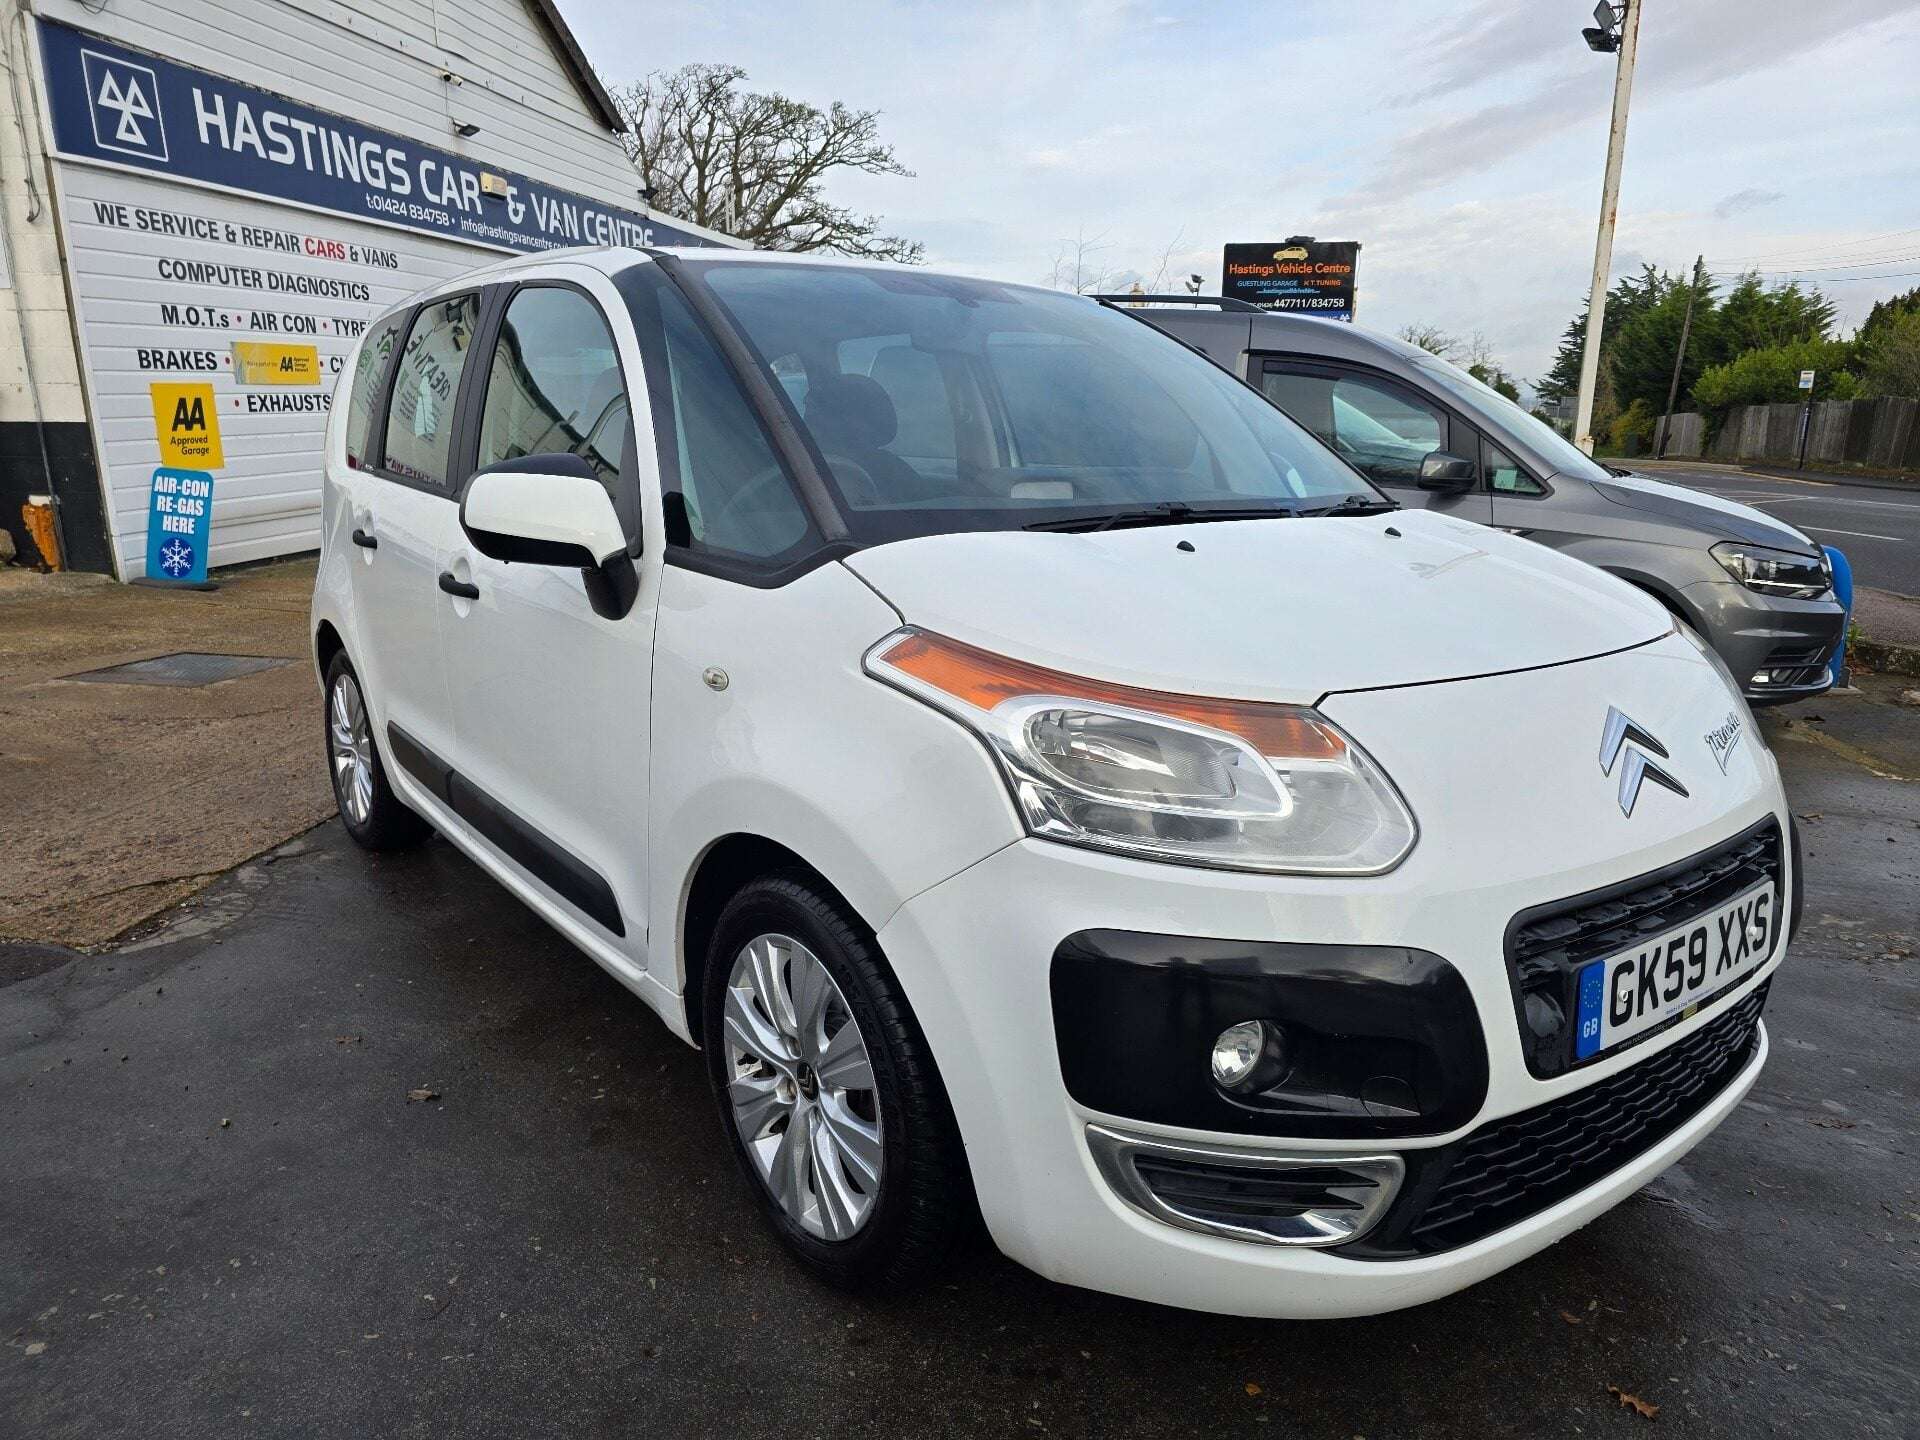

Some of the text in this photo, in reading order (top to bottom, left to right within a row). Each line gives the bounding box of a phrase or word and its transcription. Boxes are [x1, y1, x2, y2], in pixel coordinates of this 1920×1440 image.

[193, 88, 411, 196] HASTINGS
[419, 160, 483, 214] CAR
[505, 186, 526, 224] &
[530, 193, 580, 240] VAN
[409, 203, 450, 226] 834758
[94, 202, 398, 269] WE SERVICE & REPAIR CARS & VANS
[158, 258, 370, 300] COMPUTER DIAGNOSTICS
[1229, 263, 1351, 277] Hastings Vehicle Centre
[1273, 298, 1345, 308] 447711/834758
[161, 304, 370, 336] M.O.T.s AIR CON TYRE
[137, 349, 218, 371] BRAKES
[279, 356, 294, 372] AA
[247, 394, 331, 413] EXHAUSTS
[172, 397, 206, 432] AA
[170, 435, 208, 447] Approved
[181, 445, 210, 456] Garage
[154, 475, 210, 498] AIR-CON
[156, 496, 204, 517] RE-GAS
[162, 515, 195, 535] HERE
[1610, 892, 1769, 1028] GK59 XXS
[1583, 1017, 1598, 1038] GB
